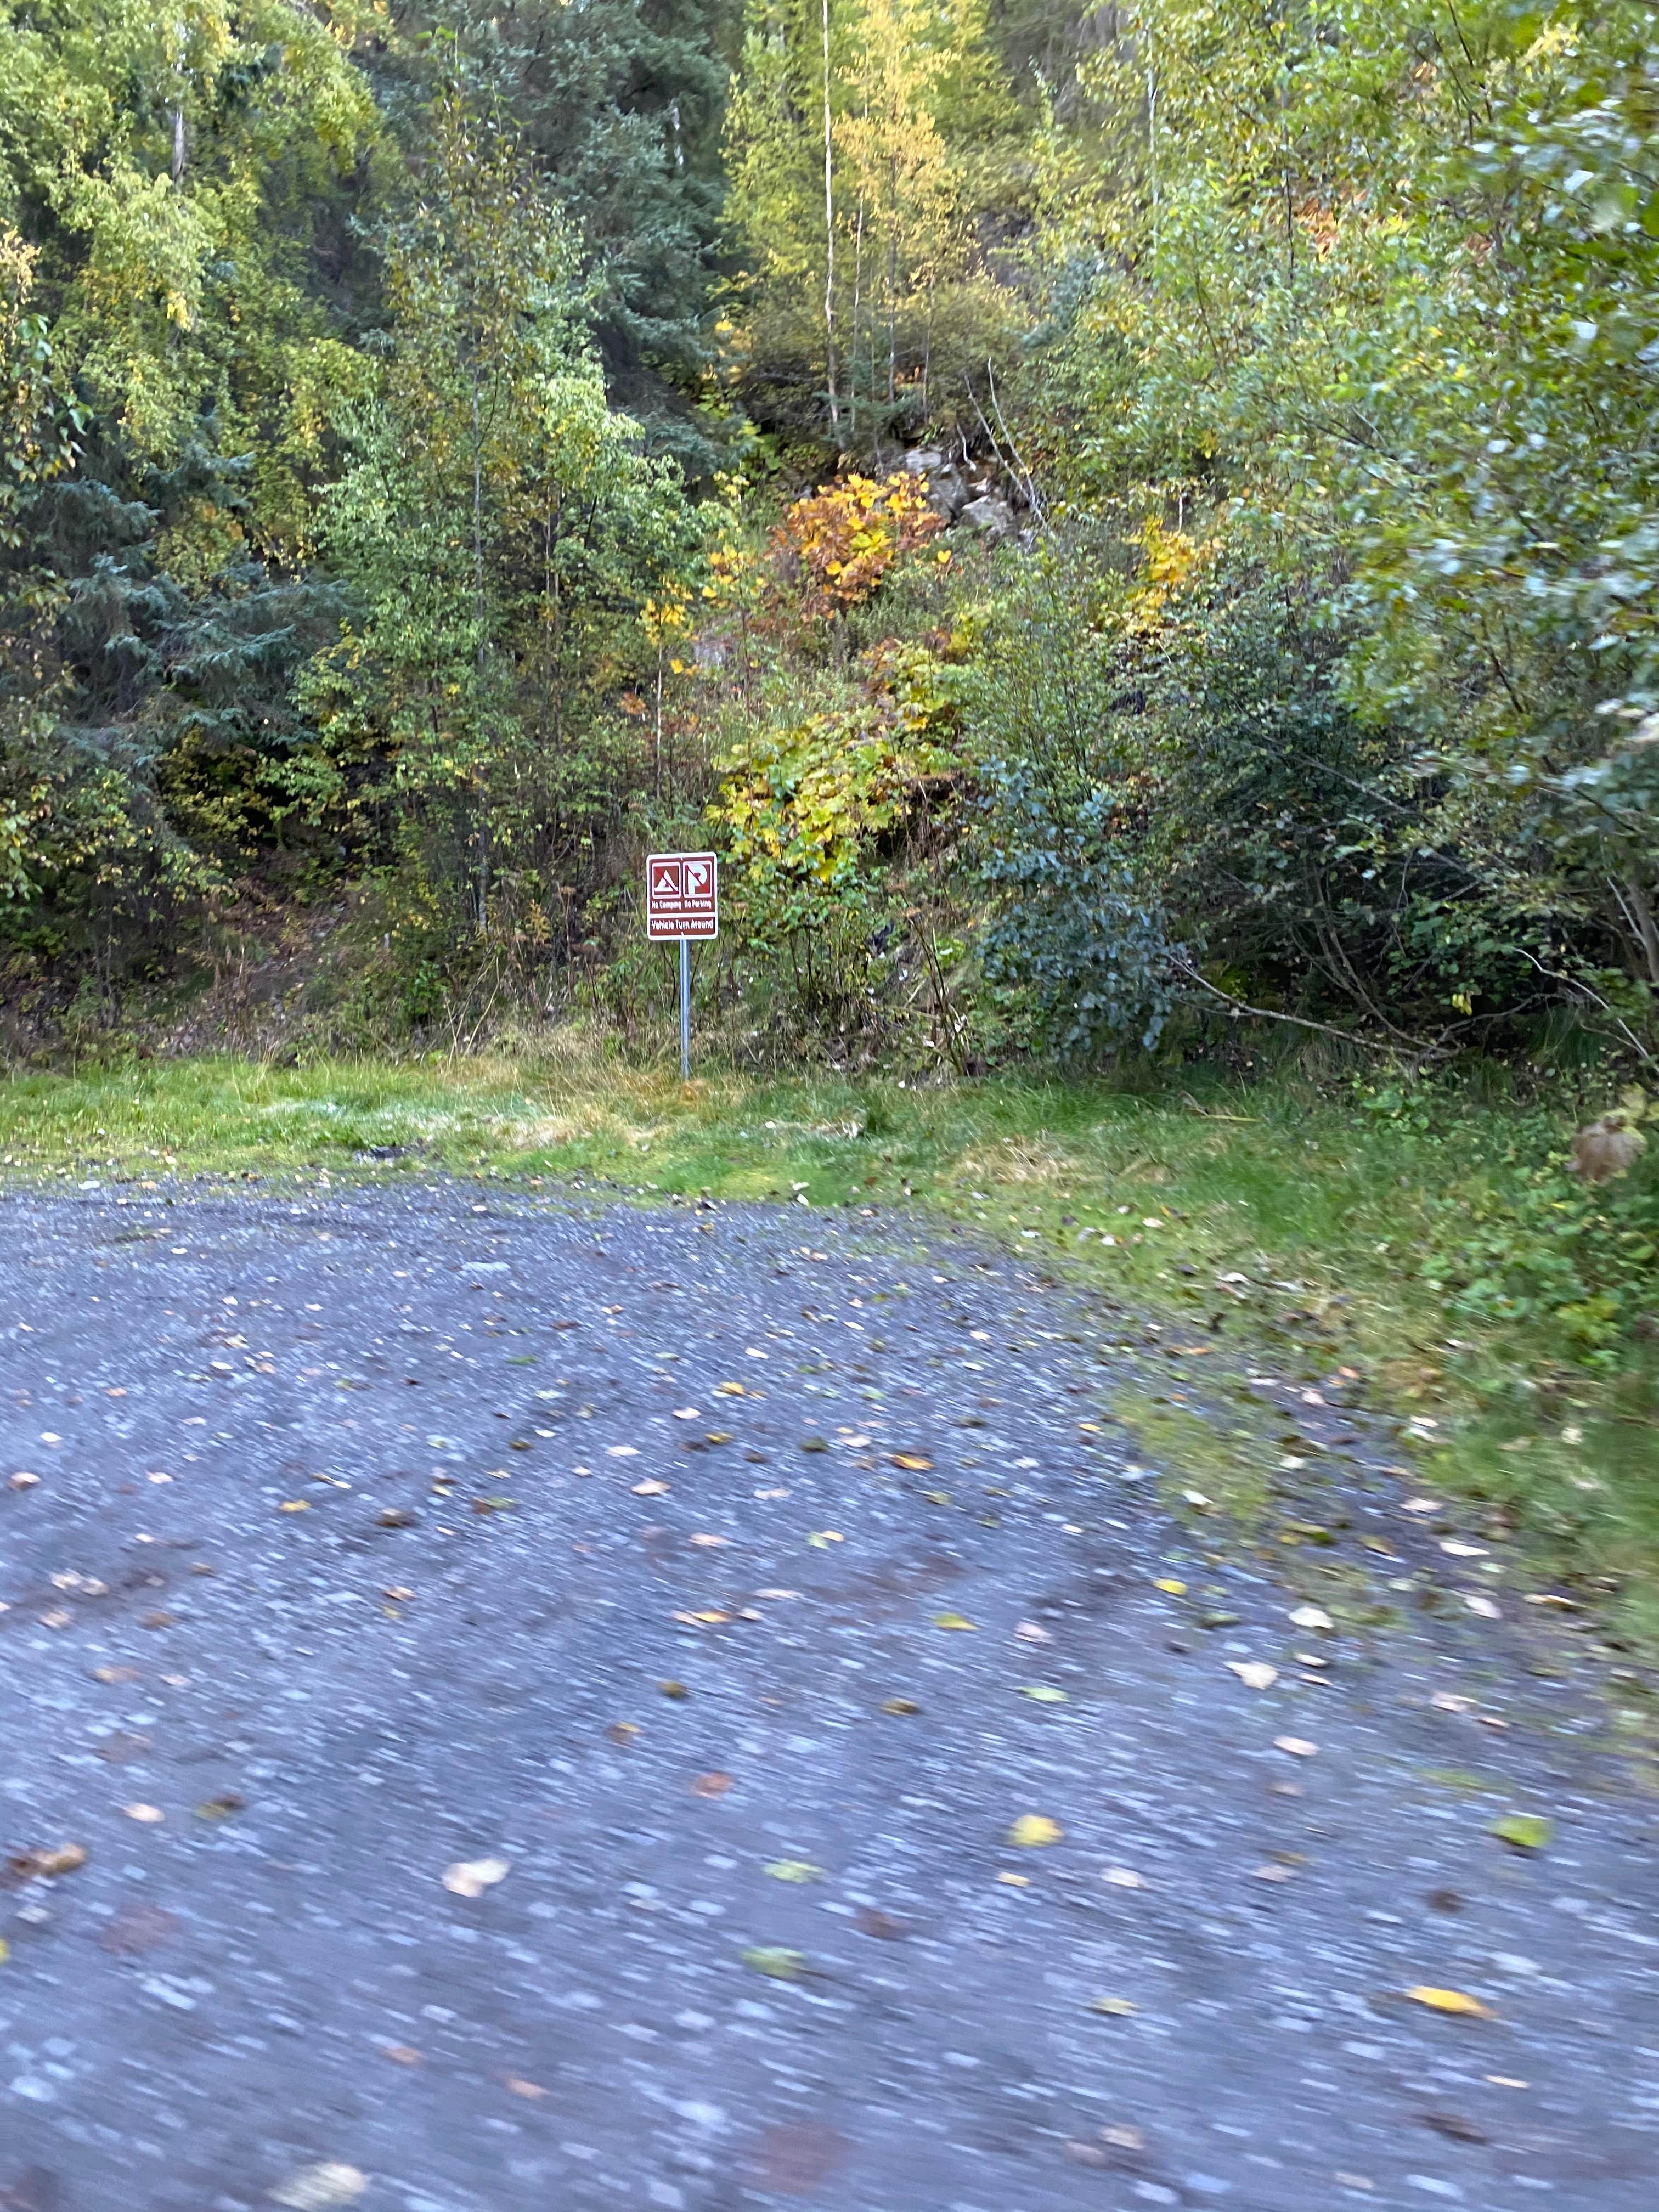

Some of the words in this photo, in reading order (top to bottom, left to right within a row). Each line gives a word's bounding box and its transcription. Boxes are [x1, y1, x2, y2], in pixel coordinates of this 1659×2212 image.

[651, 901, 659, 909] No
[659, 900, 682, 910] Camping
[684, 900, 691, 908] No
[692, 900, 712, 909] Parking
[651, 920, 674, 930] Vehicle
[675, 919, 690, 930] Turn
[691, 919, 713, 929] Around
